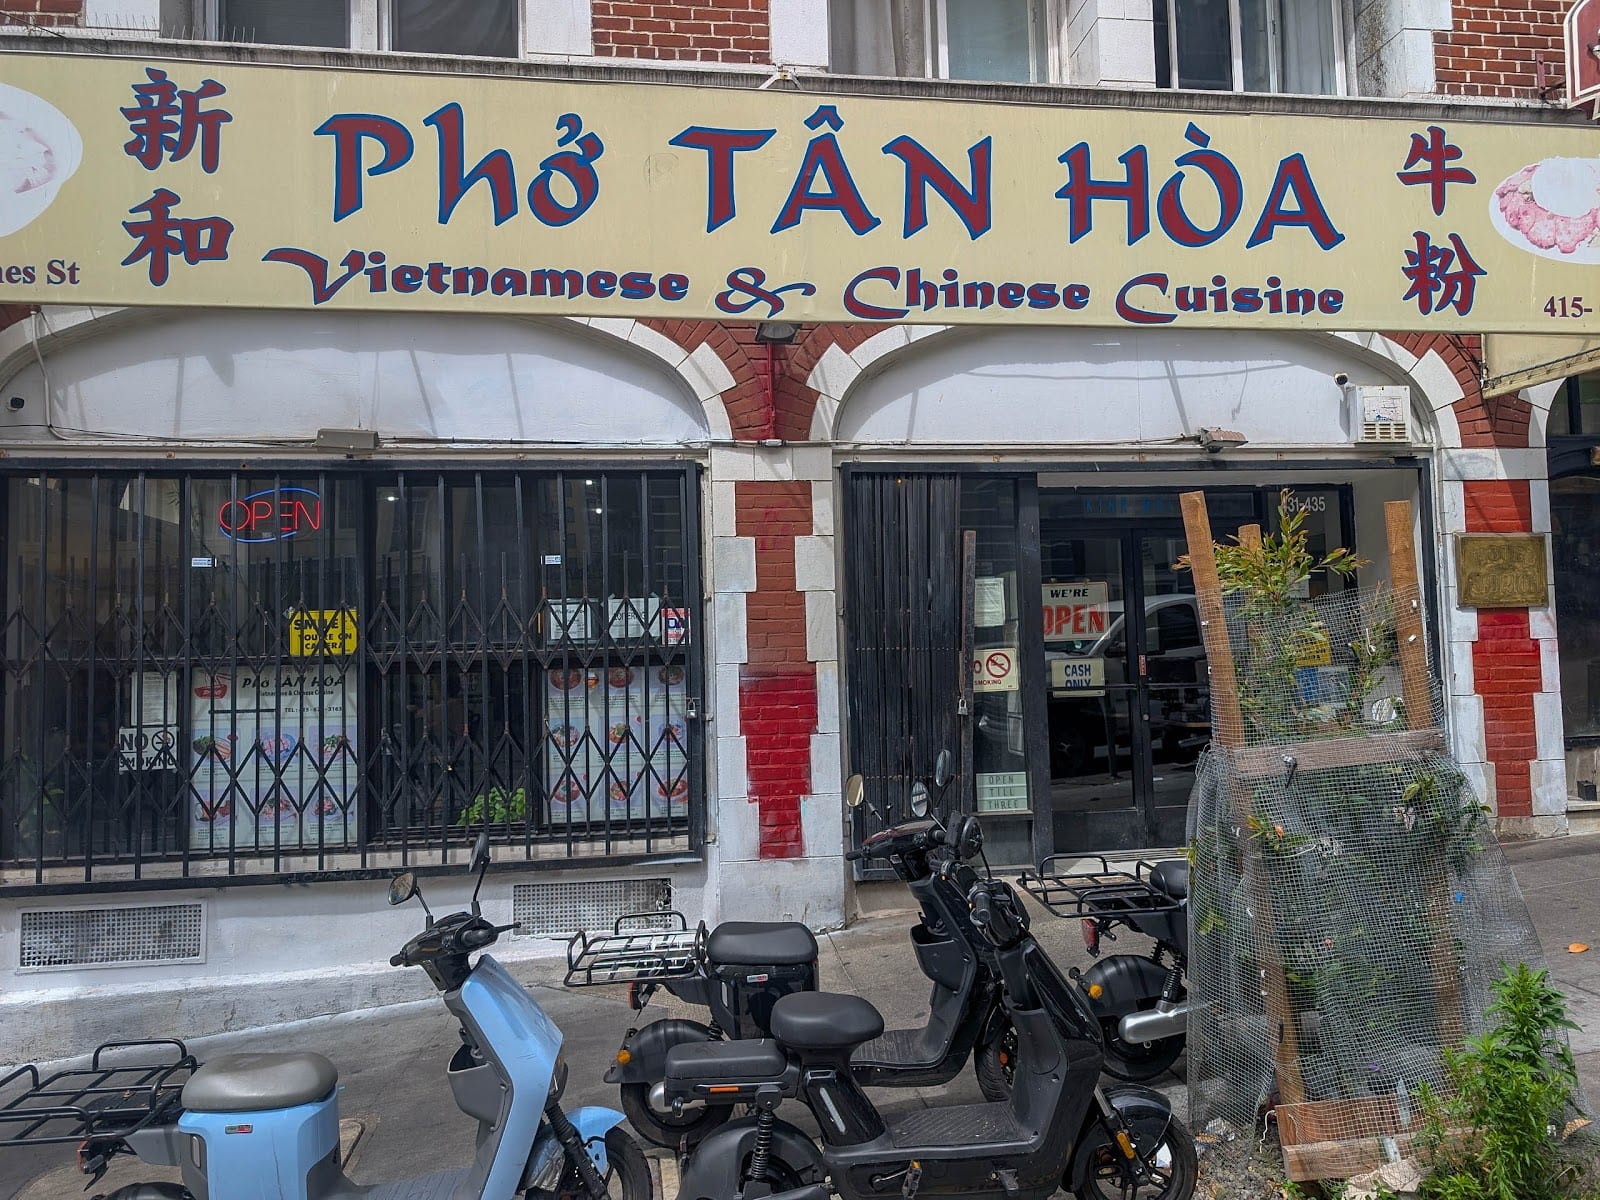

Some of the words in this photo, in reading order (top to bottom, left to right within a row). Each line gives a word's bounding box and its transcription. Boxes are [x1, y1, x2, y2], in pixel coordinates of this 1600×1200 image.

[120, 68, 233, 286] 新和
[313, 102, 604, 227] Phở
[669, 105, 991, 240] TÂN
[1055, 122, 1345, 250] HÒA
[1397, 126, 1487, 316] 牛粉
[0, 265, 36, 284] es
[47, 259, 80, 285] St
[262, 248, 689, 304] Vietnamese
[715, 268, 816, 318] &
[845, 267, 1090, 319] Chinese
[1116, 273, 1344, 324] Cuisine
[1544, 296, 1593, 317] 415-
[1281, 496, 1326, 512] 31-435
[218, 500, 321, 531] OPEN
[1050, 589, 1089, 598] WE'RE
[294, 619, 339, 630] SME
[1042, 604, 1105, 635] OPEN
[1064, 664, 1091, 677] CASH
[120, 733, 149, 750] NO
[119, 757, 175, 767] SMKNG
[988, 775, 1014, 785] OPEN
[989, 788, 1015, 798] TILL
[988, 799, 1019, 809] THREE
